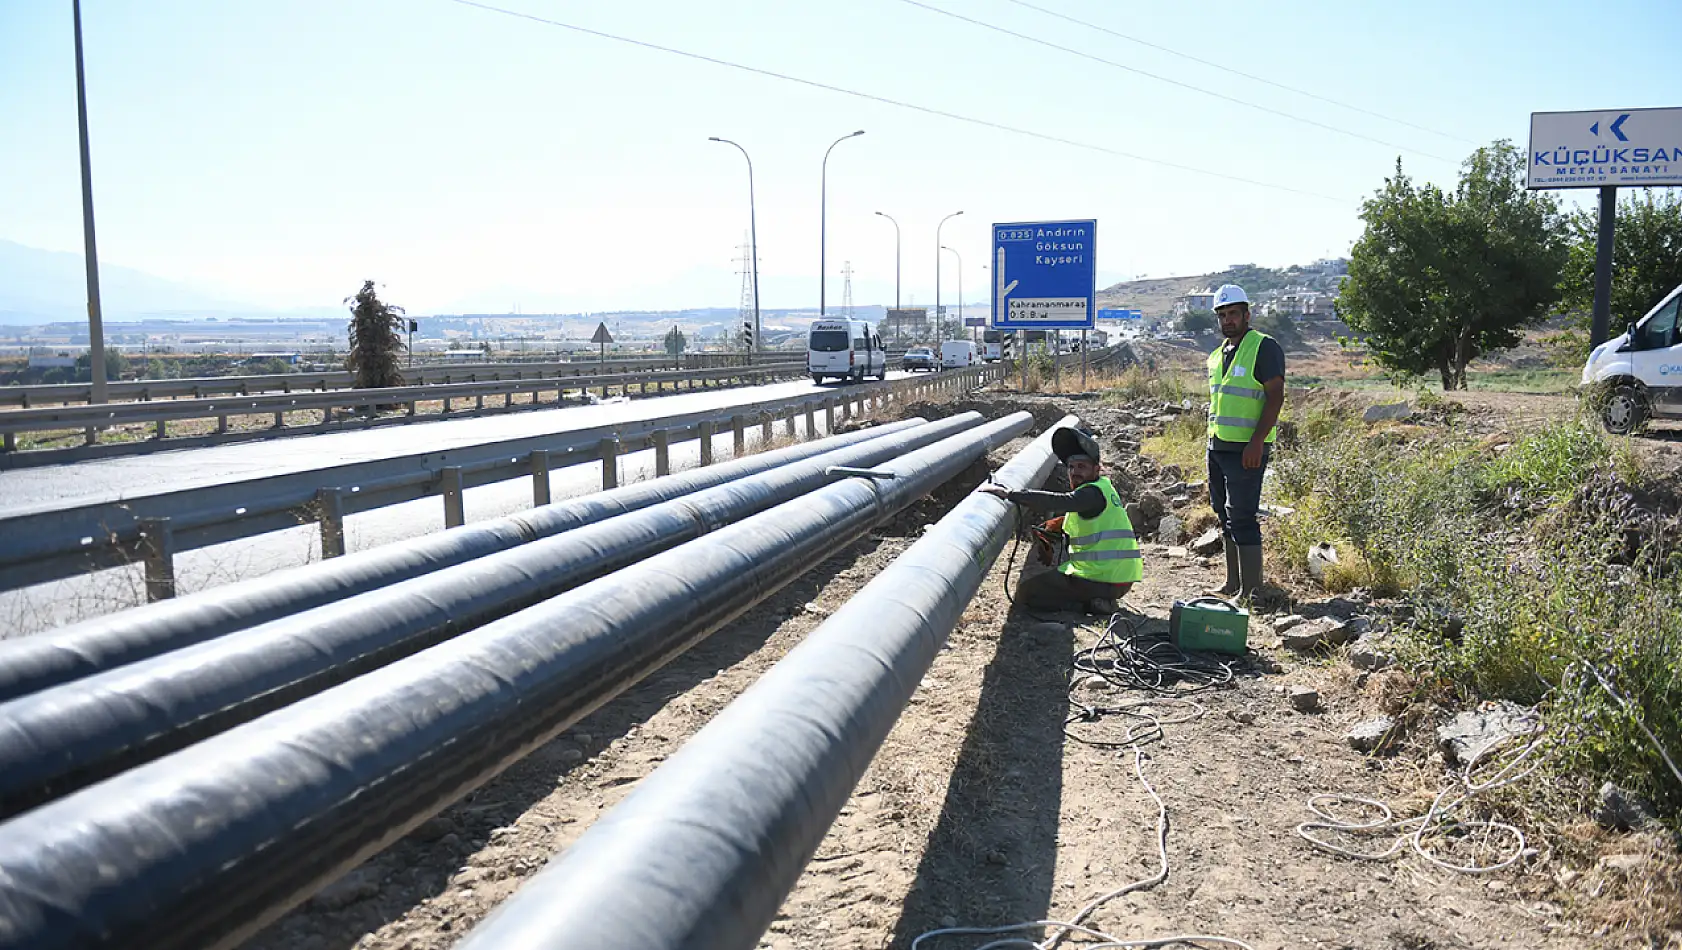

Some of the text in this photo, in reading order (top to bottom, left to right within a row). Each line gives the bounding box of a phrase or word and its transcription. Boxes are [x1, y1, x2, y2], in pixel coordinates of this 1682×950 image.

[1556, 167, 1605, 175] METAL
[1036, 228, 1085, 237] Andırın
[1035, 255, 1083, 266] Kayseri
